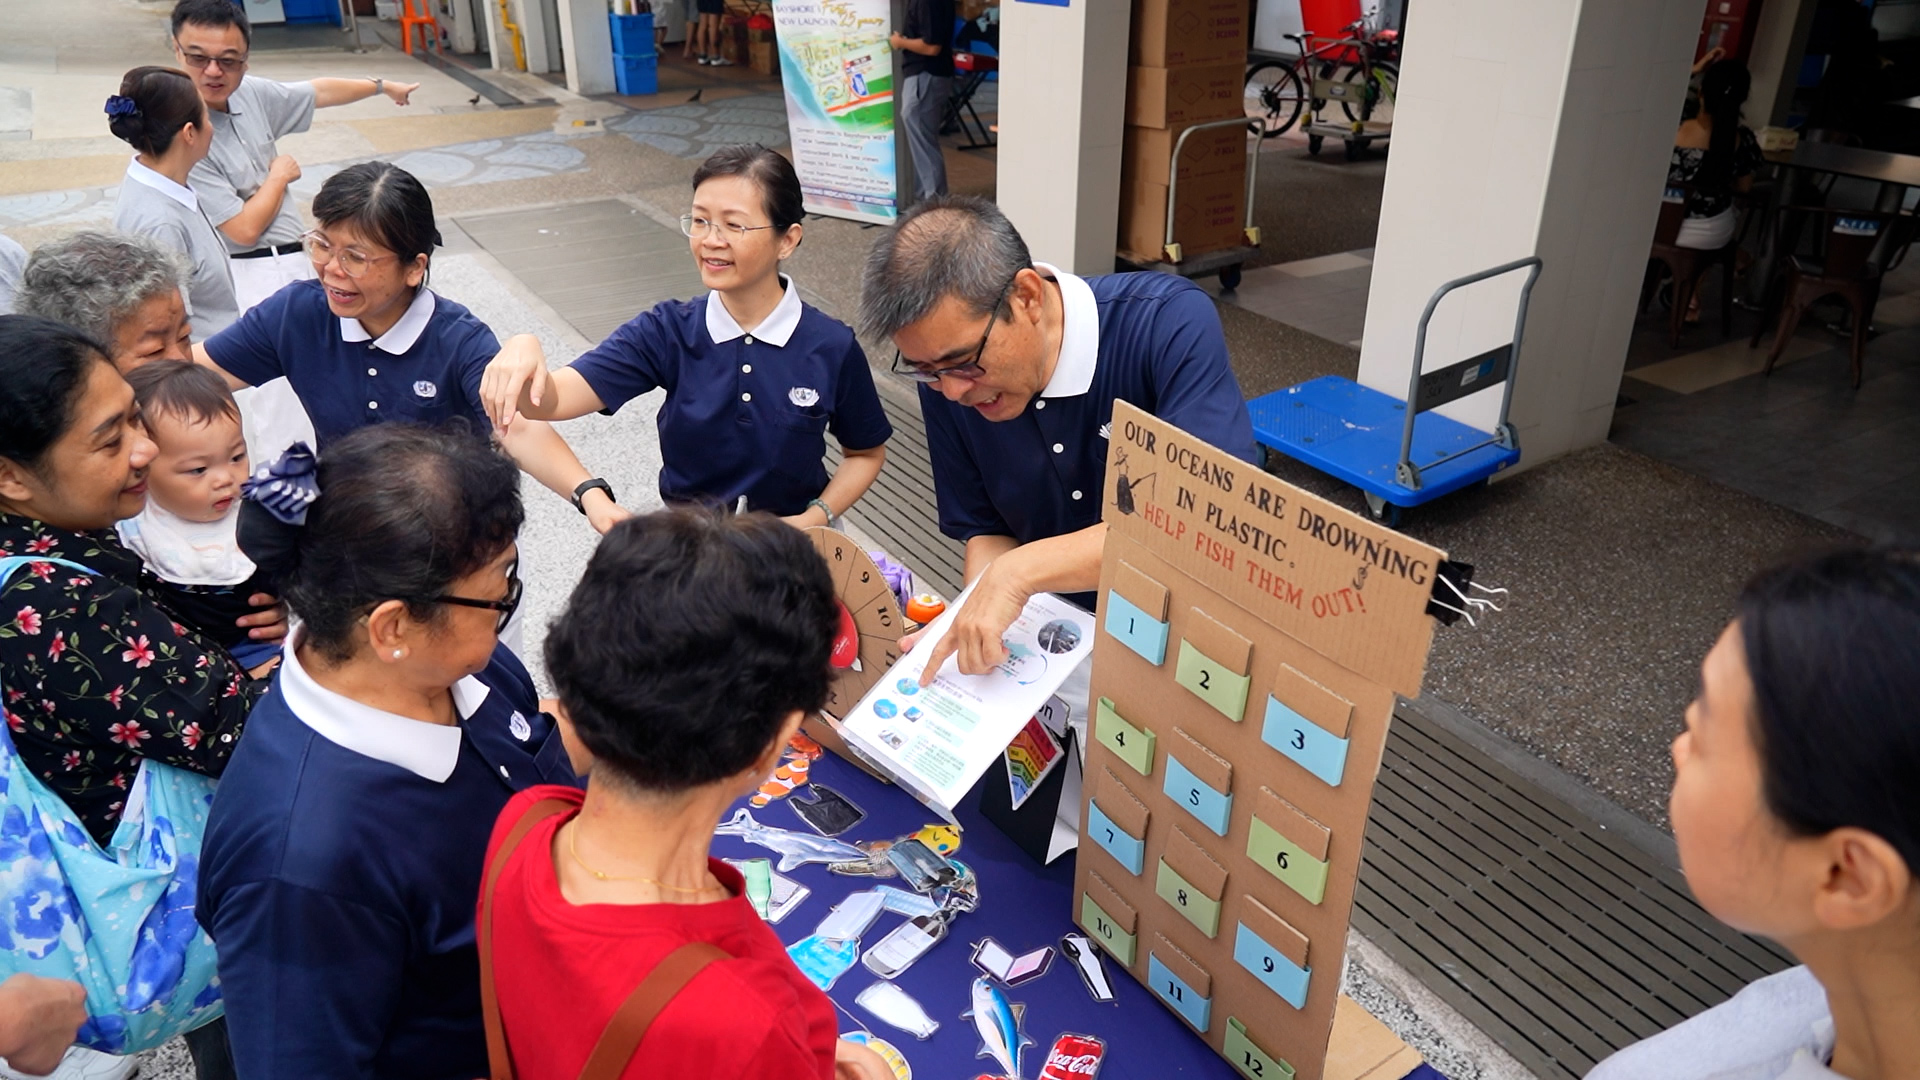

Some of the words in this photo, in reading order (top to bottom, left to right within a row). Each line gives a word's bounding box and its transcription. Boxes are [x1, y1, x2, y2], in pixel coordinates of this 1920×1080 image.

[1124, 420, 1158, 456] OUR
[1165, 442, 1236, 493] OCEANS
[1243, 481, 1286, 521] ARE
[1297, 509, 1430, 587] DROWNING
[1176, 486, 1197, 513] IN
[834, 546, 843, 562] 8
[1143, 501, 1187, 541] HELP
[1194, 531, 1236, 572] FISH
[1245, 560, 1303, 611] THEM
[1311, 587, 1368, 620] OUT!
[860, 571, 870, 584] 9
[877, 605, 892, 628] 10
[1127, 617, 1136, 635] 1
[1198, 669, 1211, 691] 2
[1114, 730, 1126, 748] 4
[1290, 729, 1306, 750] 3
[1188, 788, 1200, 806] 5
[1105, 828, 1115, 845] 7
[1276, 851, 1289, 870] 6
[1176, 889, 1188, 907] 8
[1095, 917, 1113, 940] 10
[1262, 956, 1275, 974] 9
[1167, 980, 1183, 1004] 11
[1050, 1048, 1100, 1076] oca-Cola
[1243, 1050, 1264, 1077] 12
